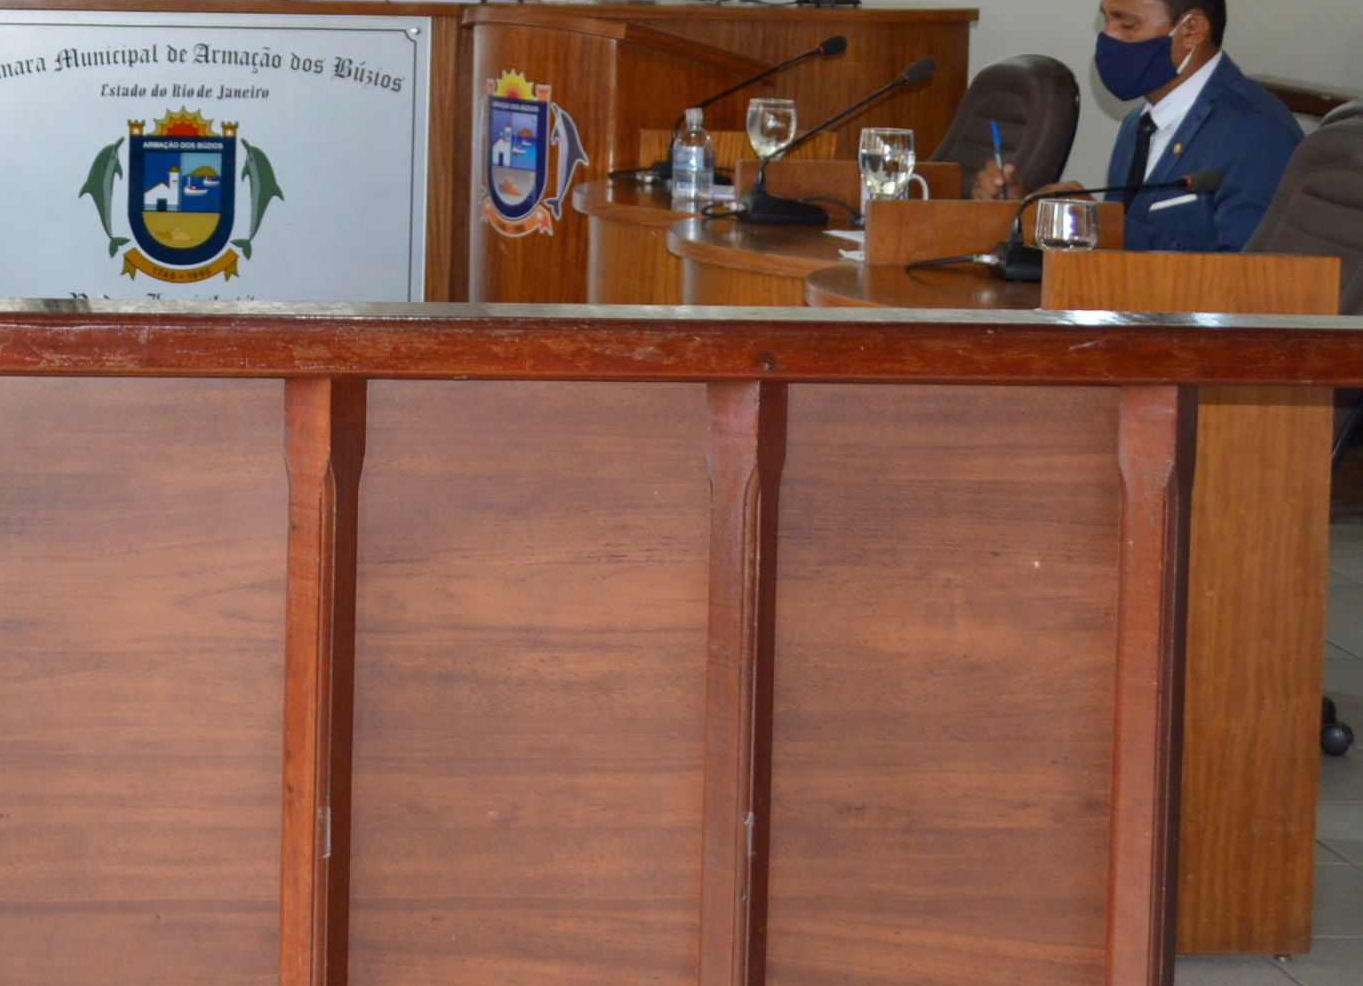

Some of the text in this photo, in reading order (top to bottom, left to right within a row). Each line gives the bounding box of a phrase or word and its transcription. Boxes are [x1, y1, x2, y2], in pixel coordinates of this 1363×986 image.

[53, 44, 159, 72] Municipal
[167, 44, 188, 63] de
[192, 43, 282, 74] Armação
[289, 51, 326, 74] dos
[331, 56, 406, 92] Búzios
[101, 83, 270, 100] Estado do Rio de Janeiro
[142, 140, 180, 150] ARMAÇÃO
